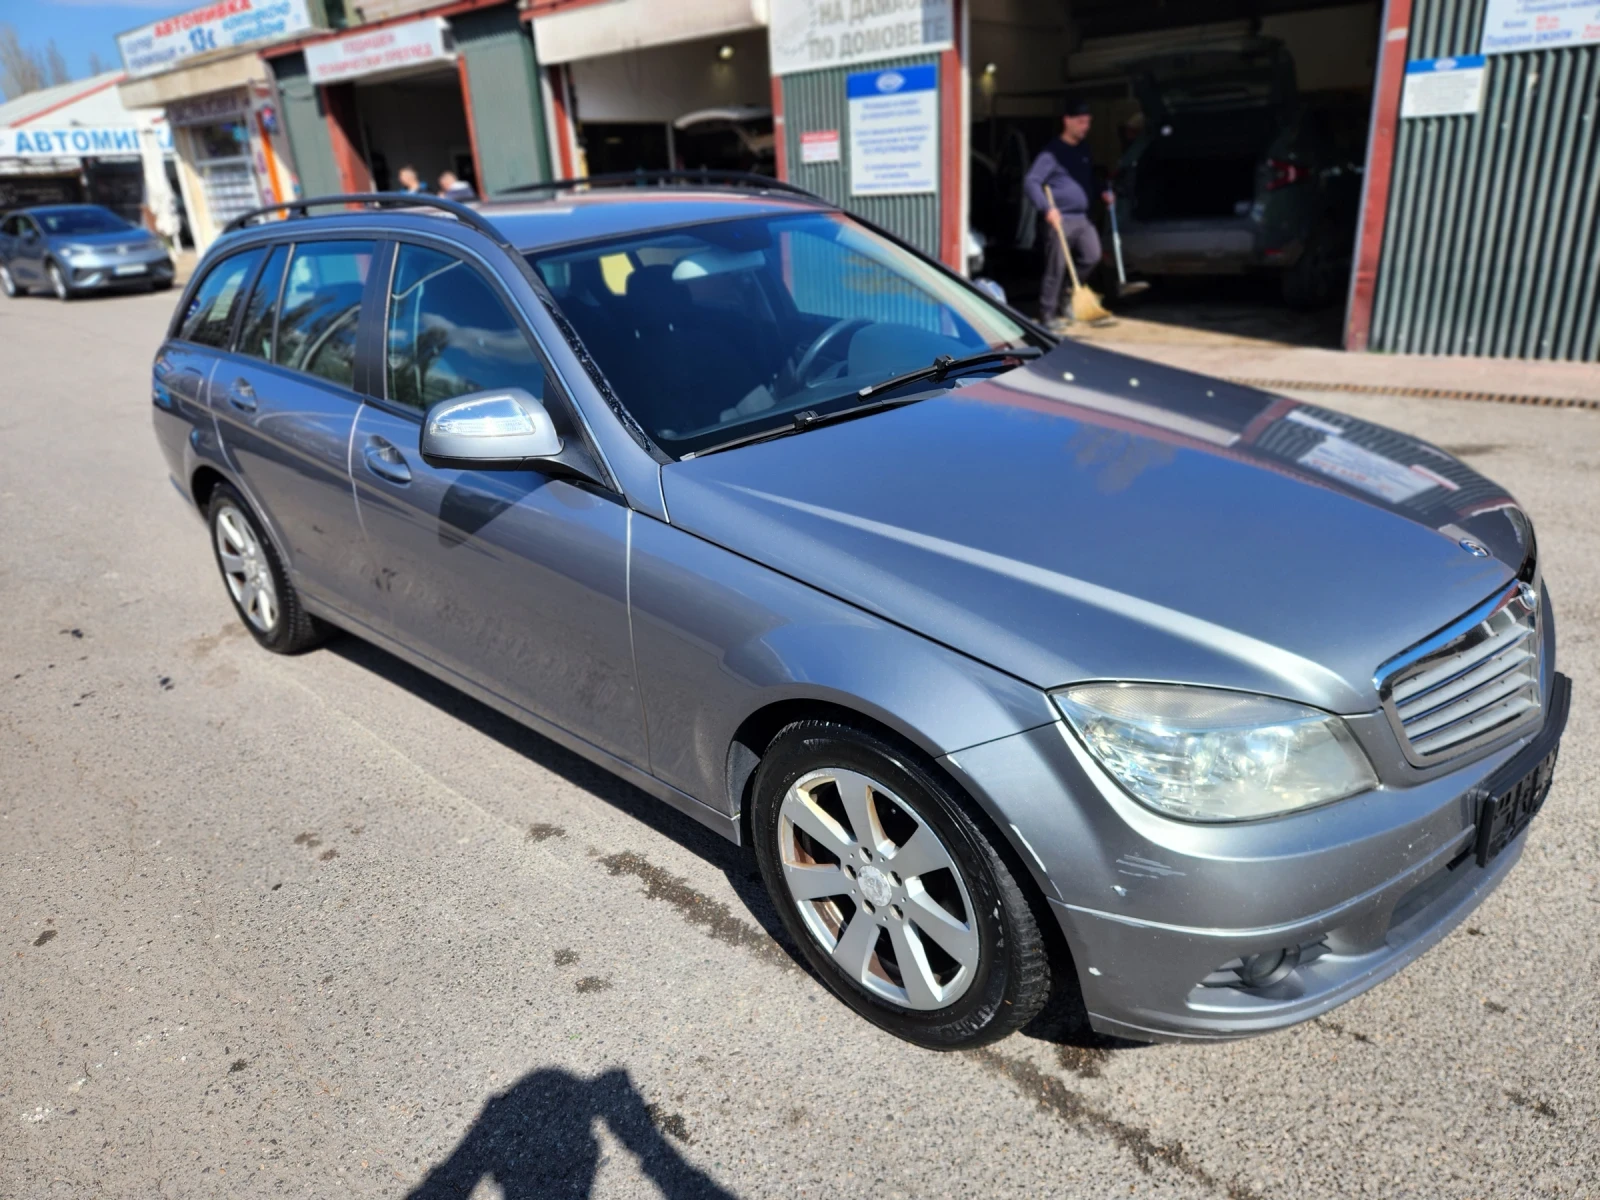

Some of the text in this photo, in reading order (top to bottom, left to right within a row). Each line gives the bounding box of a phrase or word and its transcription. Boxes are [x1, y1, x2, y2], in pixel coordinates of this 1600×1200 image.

[153, 0, 253, 38] АВТОМИВКА
[839, 17, 947, 58] ДОМОВЕТЕ
[16, 129, 174, 152] АВТОМИ
